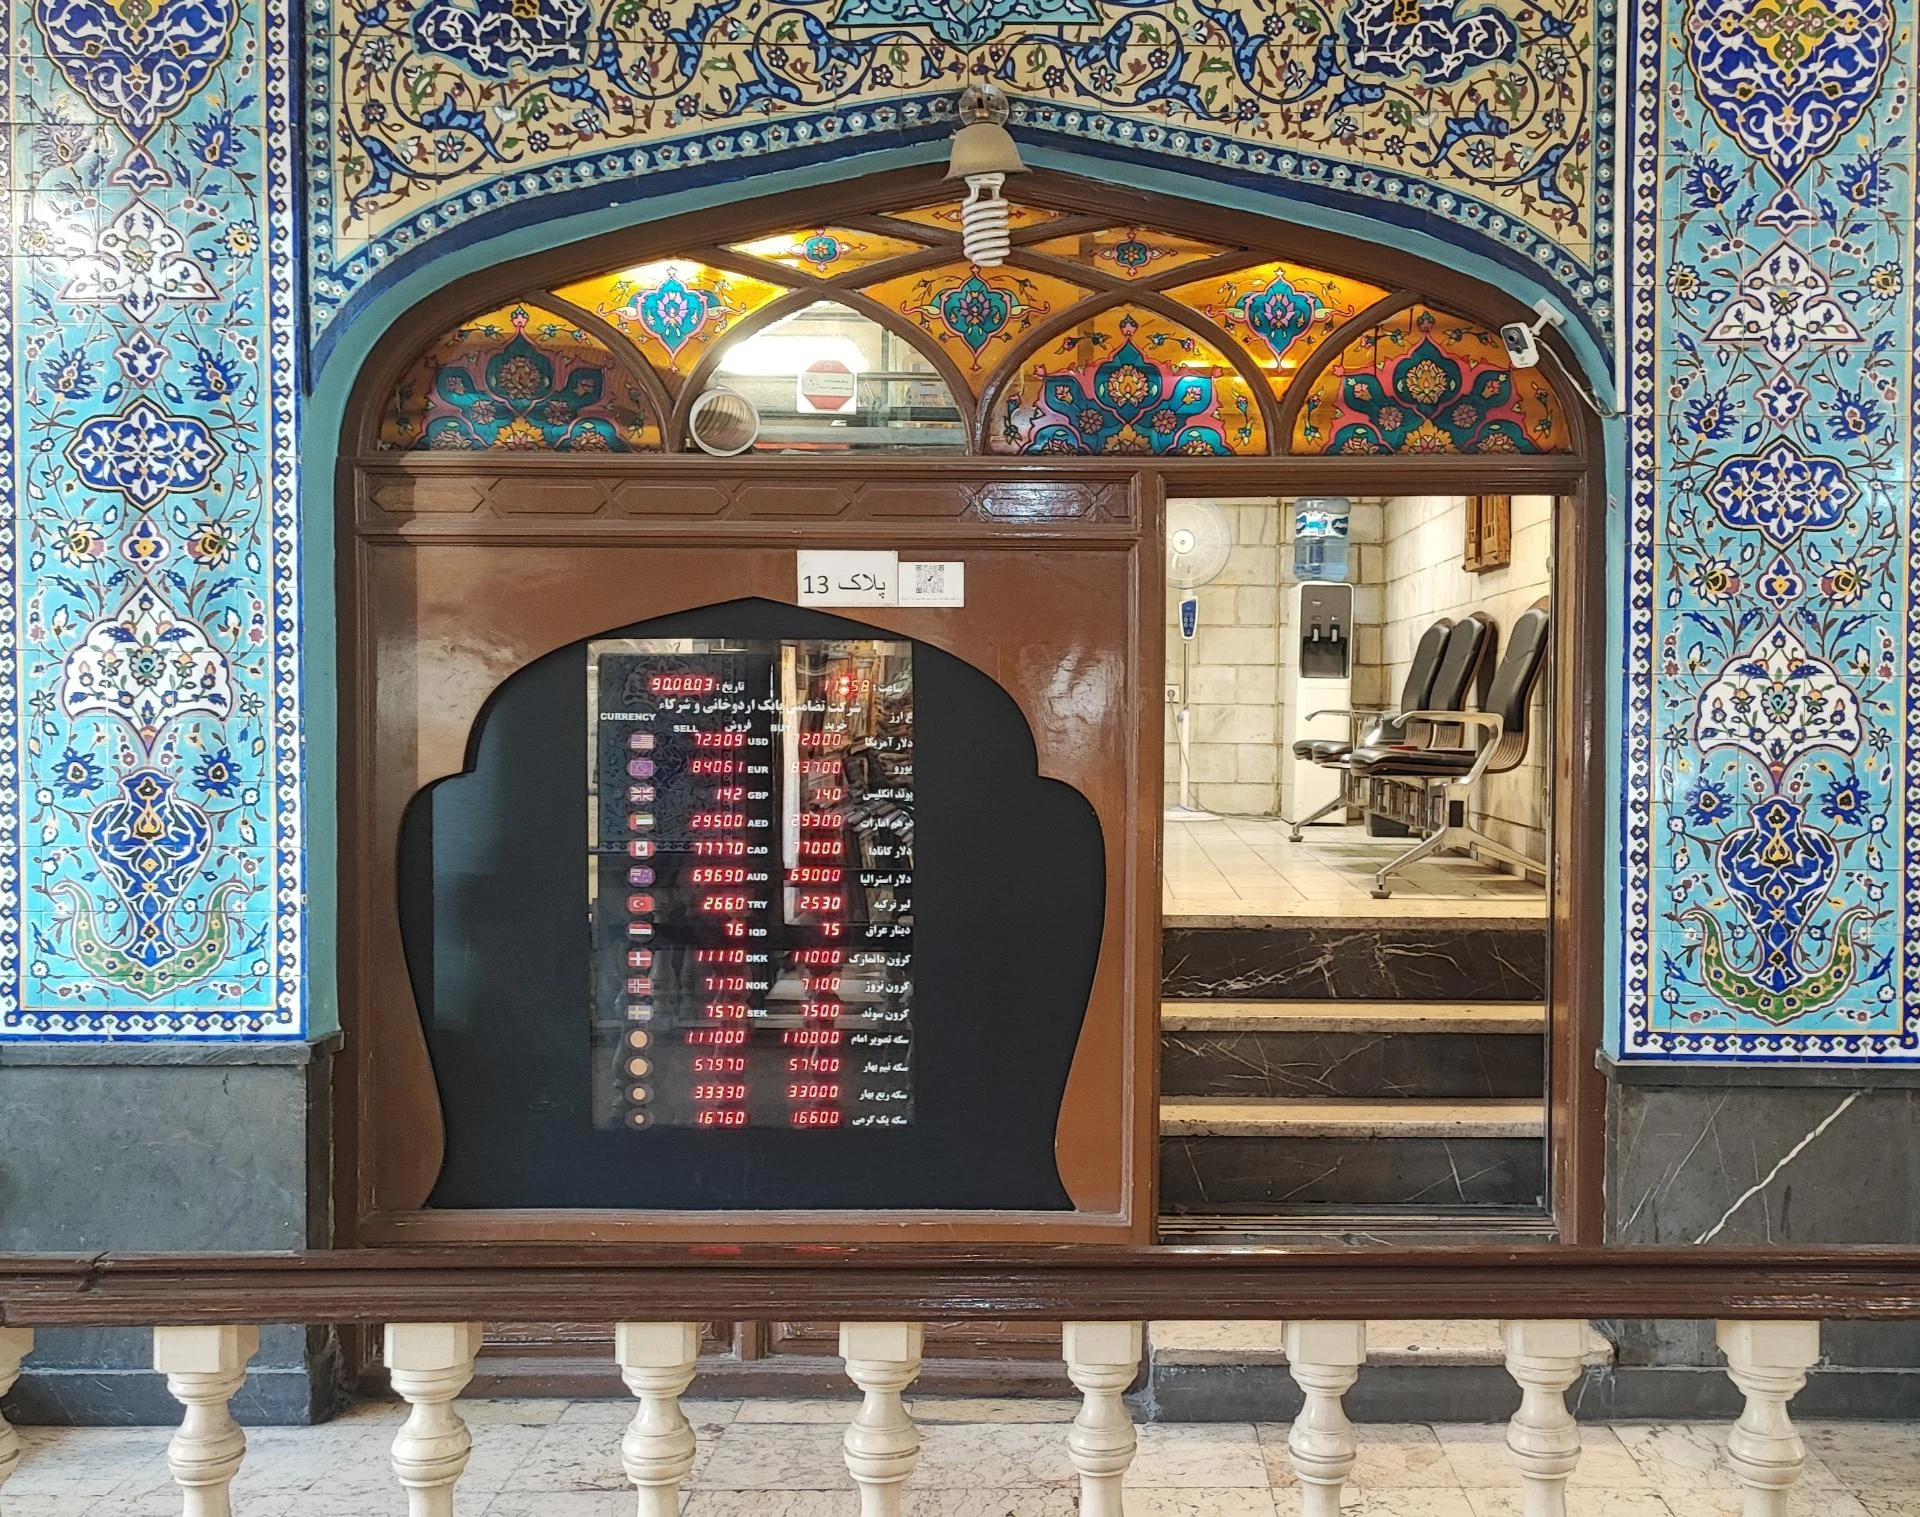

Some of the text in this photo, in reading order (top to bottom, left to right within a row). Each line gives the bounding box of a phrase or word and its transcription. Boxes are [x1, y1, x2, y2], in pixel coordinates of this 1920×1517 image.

[803, 574, 886, 598] پلاک 13
[824, 676, 870, 695] 11:58
[658, 698, 691, 714] شرکاء
[693, 702, 700, 714] و
[702, 698, 756, 714] اردوخانی
[827, 701, 862, 716] شرکت
[600, 712, 656, 722] CURRENCY
[724, 718, 752, 732] فروش
[770, 724, 790, 732] BUY
[824, 720, 848, 732] خرید
[694, 734, 743, 746] 72309
[748, 738, 768, 746] USD
[794, 734, 842, 746] 72000
[865, 736, 913, 750] دلار آمریکا
[692, 760, 743, 773] 84061
[748, 766, 768, 774] EUR
[791, 761, 841, 774] 83700
[894, 765, 912, 775] یورو
[716, 788, 742, 800] 142
[748, 792, 768, 800] GBP
[816, 788, 841, 800] 140
[894, 788, 914, 802] پوند
[692, 815, 742, 826] 29500
[790, 815, 841, 827] 29300
[860, 817, 914, 831] درهم امارات
[695, 843, 743, 855] 77770
[747, 846, 768, 855] CAD
[794, 842, 841, 855] 77000
[868, 845, 912, 858] دلار کانادا
[693, 870, 744, 882] 69690
[790, 869, 840, 880] 69000
[860, 874, 912, 886] دلار استرالیا
[703, 898, 744, 910] 2660
[800, 897, 840, 910] 2530
[874, 899, 911, 911] لیر ترکیه
[727, 924, 743, 936] 76
[749, 929, 767, 937] IQD
[822, 923, 840, 936] 75
[865, 925, 911, 937] دینار عراق
[698, 950, 743, 962] 11110
[746, 955, 768, 963] DKK
[794, 951, 840, 963] 11000
[848, 954, 911, 966] کرون دانمارک
[746, 982, 768, 990] NOK
[802, 978, 840, 990] 7100
[885, 981, 910, 993] کرون
[706, 1006, 744, 1018] 7570
[802, 1005, 839, 1017] 7500
[861, 1007, 910, 1021] کرون سوئد
[688, 1031, 744, 1044] 111000
[784, 1032, 839, 1044] 110000
[850, 1034, 909, 1046] سکه تصویر امام
[695, 1059, 744, 1071] 57970
[790, 1059, 839, 1071] 57400
[892, 1063, 908, 1071] سکه
[695, 1086, 744, 1098] 33330
[788, 1086, 838, 1098] 33000
[891, 1090, 908, 1099] سکه
[699, 1112, 744, 1124] 16760
[794, 1112, 839, 1124] 16600
[876, 1115, 890, 1126] یک
[891, 1116, 907, 1124] سکه
